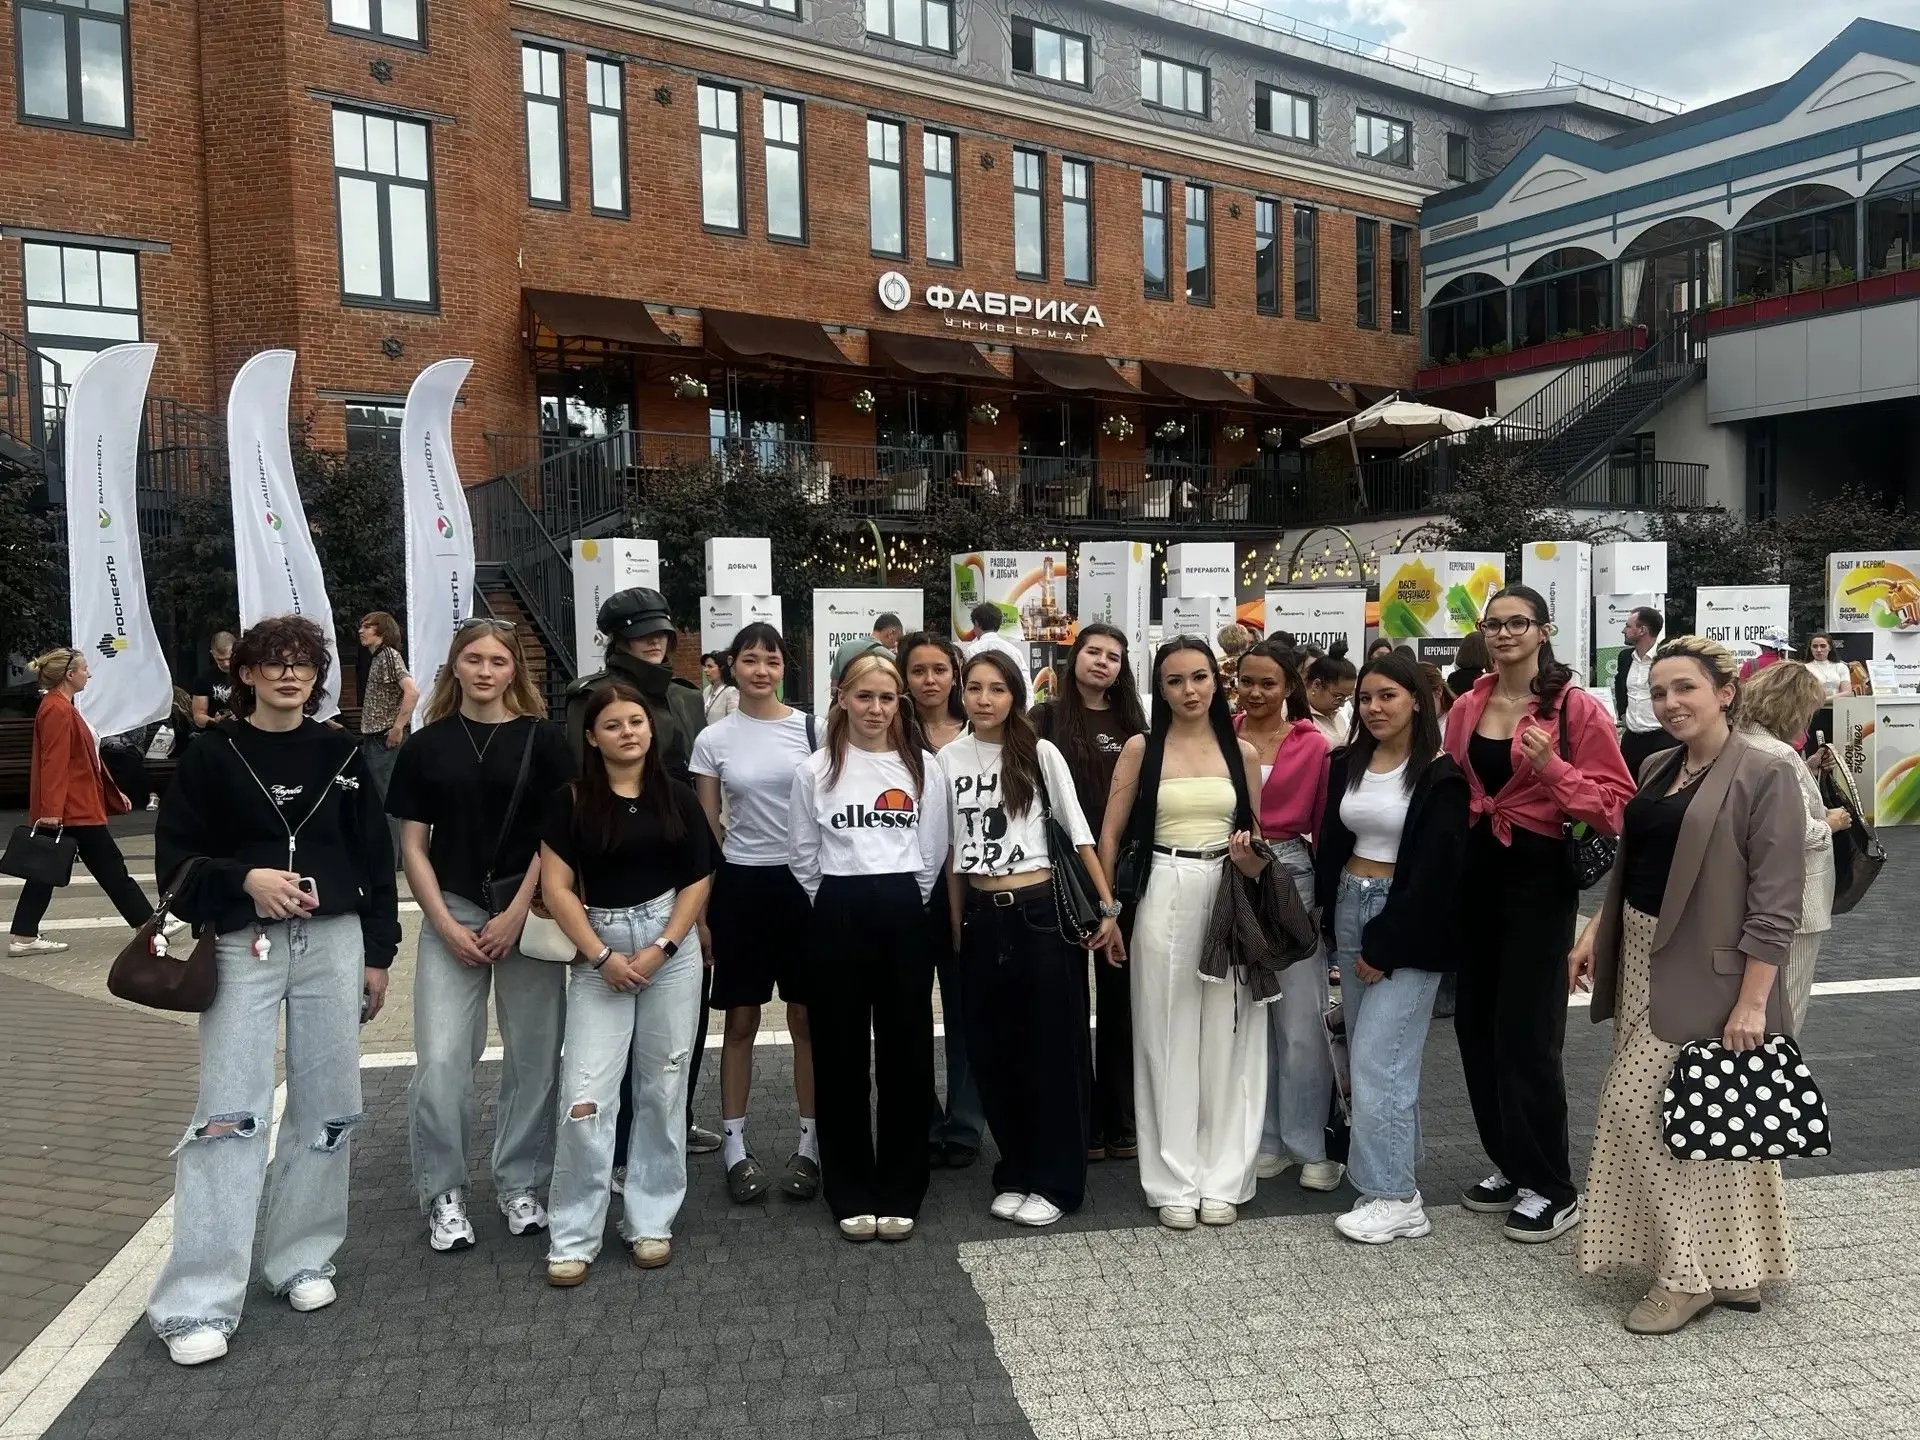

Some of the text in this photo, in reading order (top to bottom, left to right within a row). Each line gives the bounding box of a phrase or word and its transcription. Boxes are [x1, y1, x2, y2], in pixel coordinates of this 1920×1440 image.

[926, 285, 1104, 328] ФАБРИКА
[945, 317, 1088, 342] УНИВЕРМАГ
[423, 430, 444, 511] БАШНЕФТЬ
[990, 558, 1017, 568] РАЗВЕДКА
[997, 570, 1018, 579] ДОБЫЧА
[1837, 561, 1853, 569] СБЫТ
[1863, 560, 1885, 569] СЕРВИС
[106, 555, 126, 636] РОСНЕФТЬ
[451, 570, 460, 634] НЕФТЬ
[1706, 625, 1774, 640] СБЫТ И СЕРВ
[831, 804, 919, 829] ellesse
